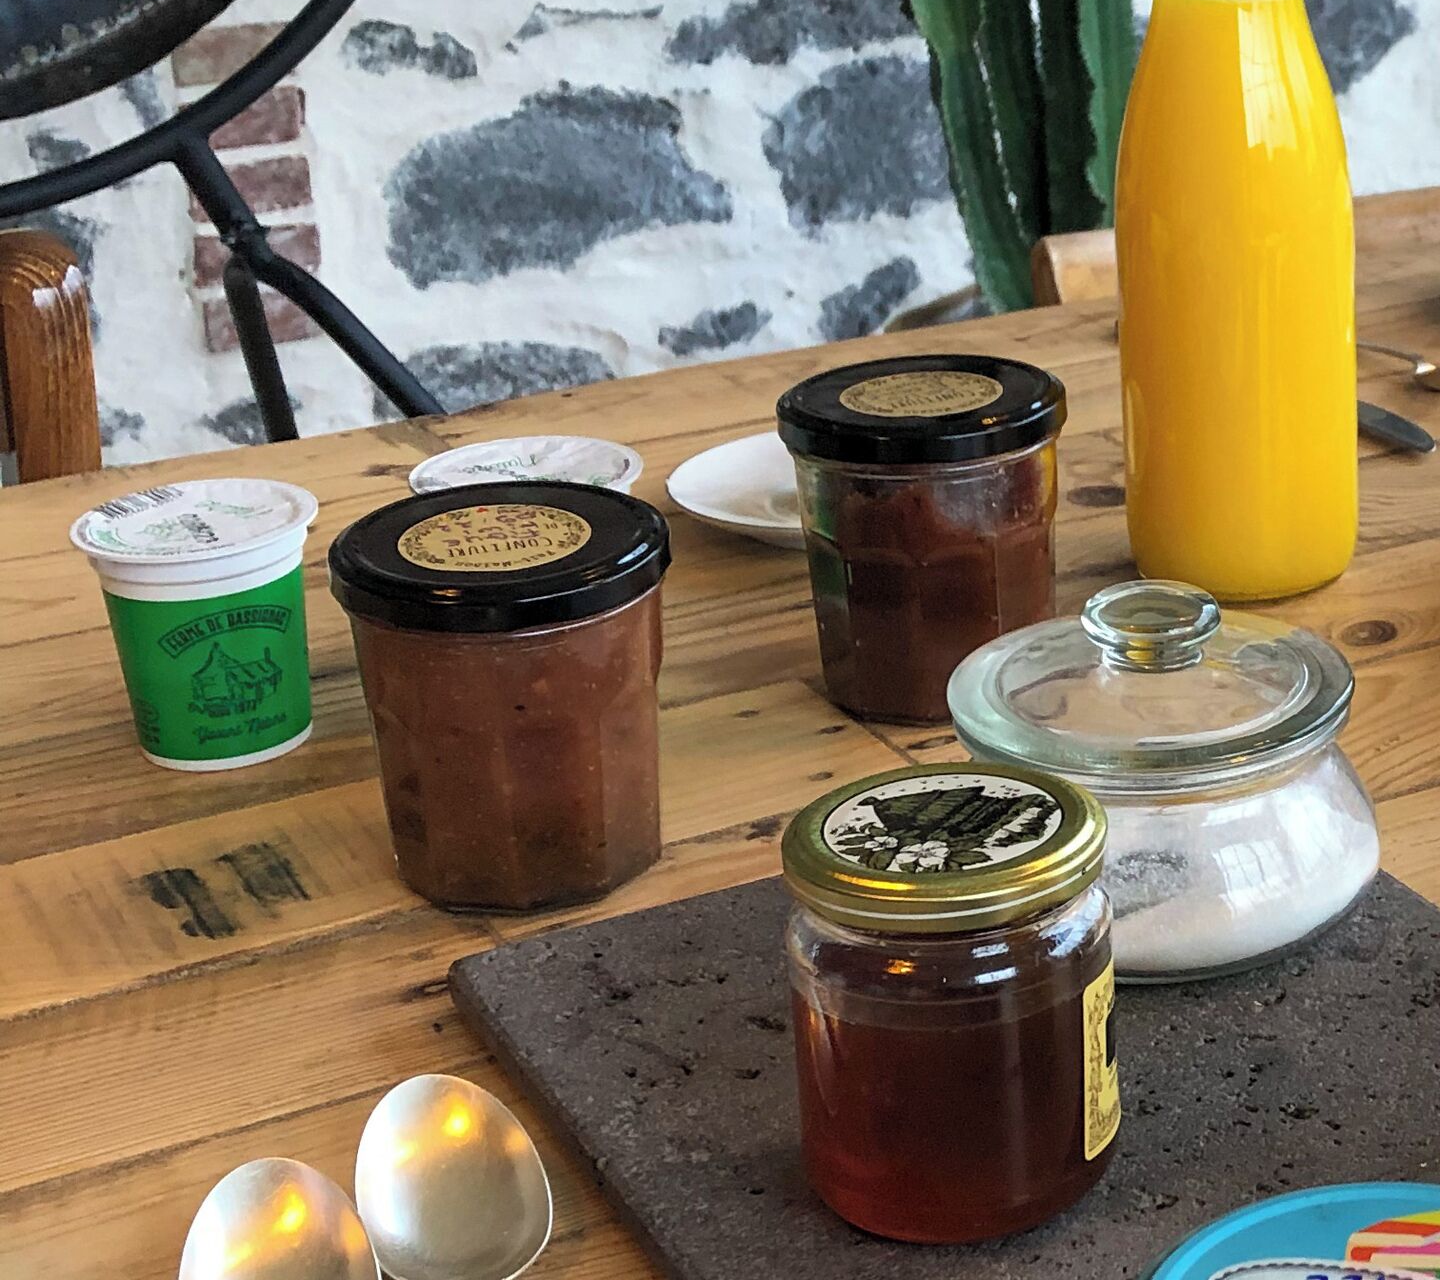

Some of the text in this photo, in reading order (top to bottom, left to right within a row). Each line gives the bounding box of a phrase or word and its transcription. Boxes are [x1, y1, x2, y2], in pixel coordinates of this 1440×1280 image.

[447, 536, 554, 558] CONFITURE
[167, 624, 205, 651] FERME
[207, 616, 223, 632] DE
